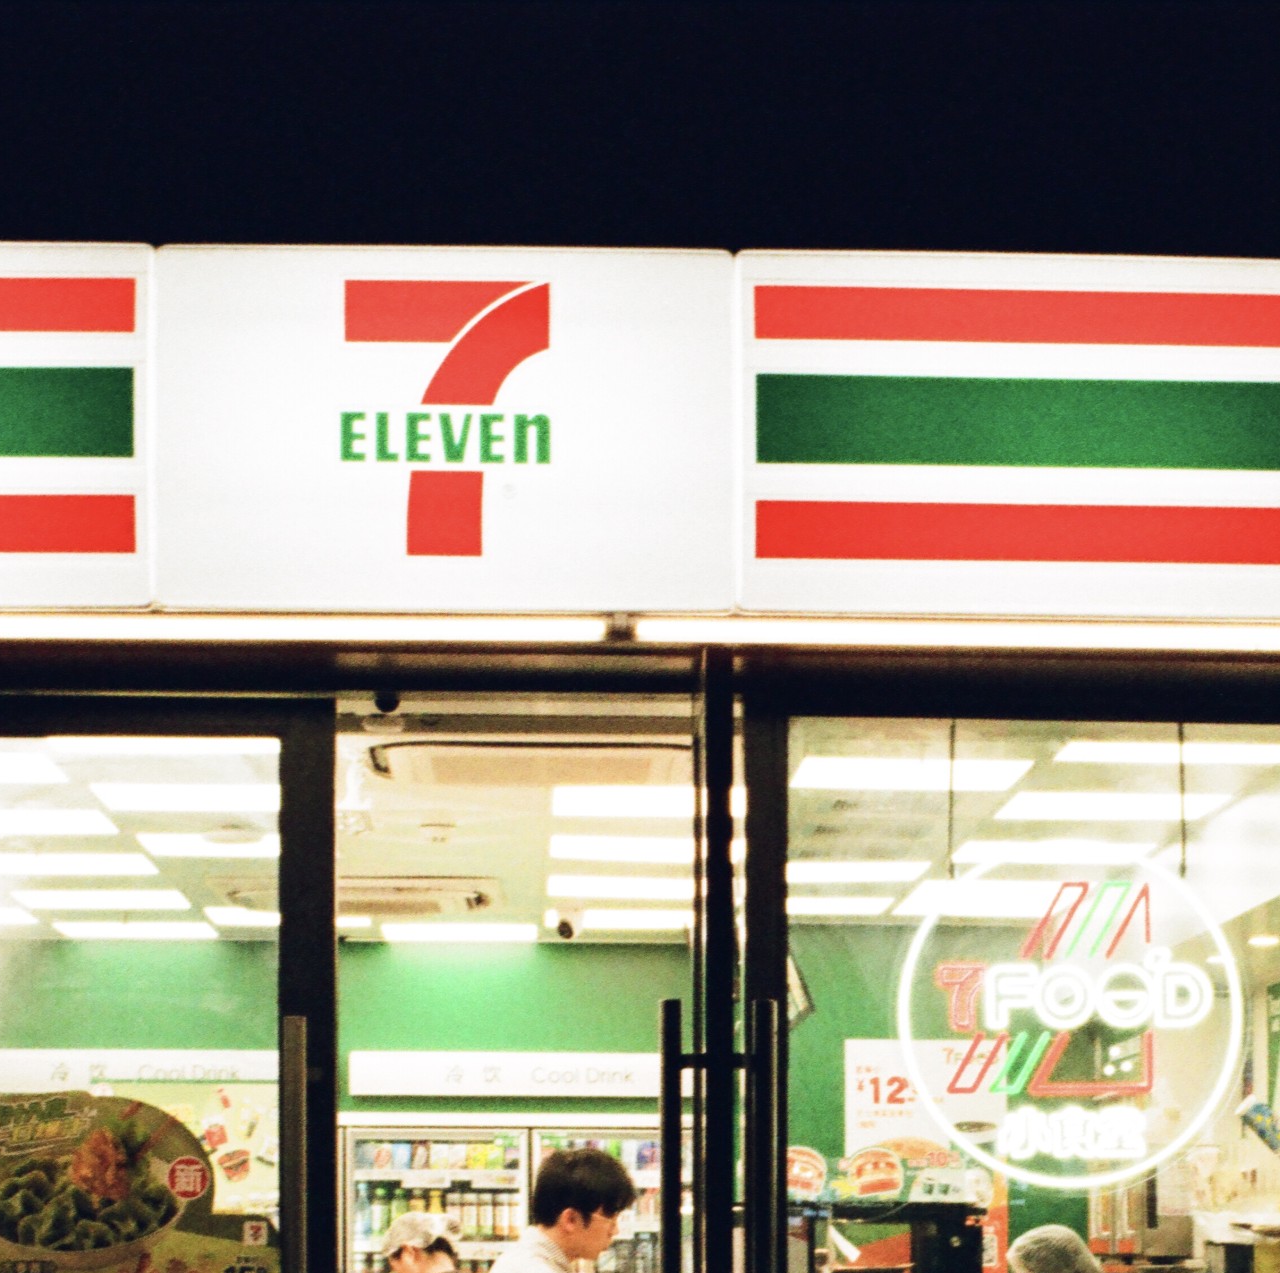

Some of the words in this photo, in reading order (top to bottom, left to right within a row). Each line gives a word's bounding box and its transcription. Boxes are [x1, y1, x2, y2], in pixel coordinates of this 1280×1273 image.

[344, 279, 550, 556] 7
[531, 1065, 578, 1085] Cool
[585, 1065, 635, 1085] Drink
